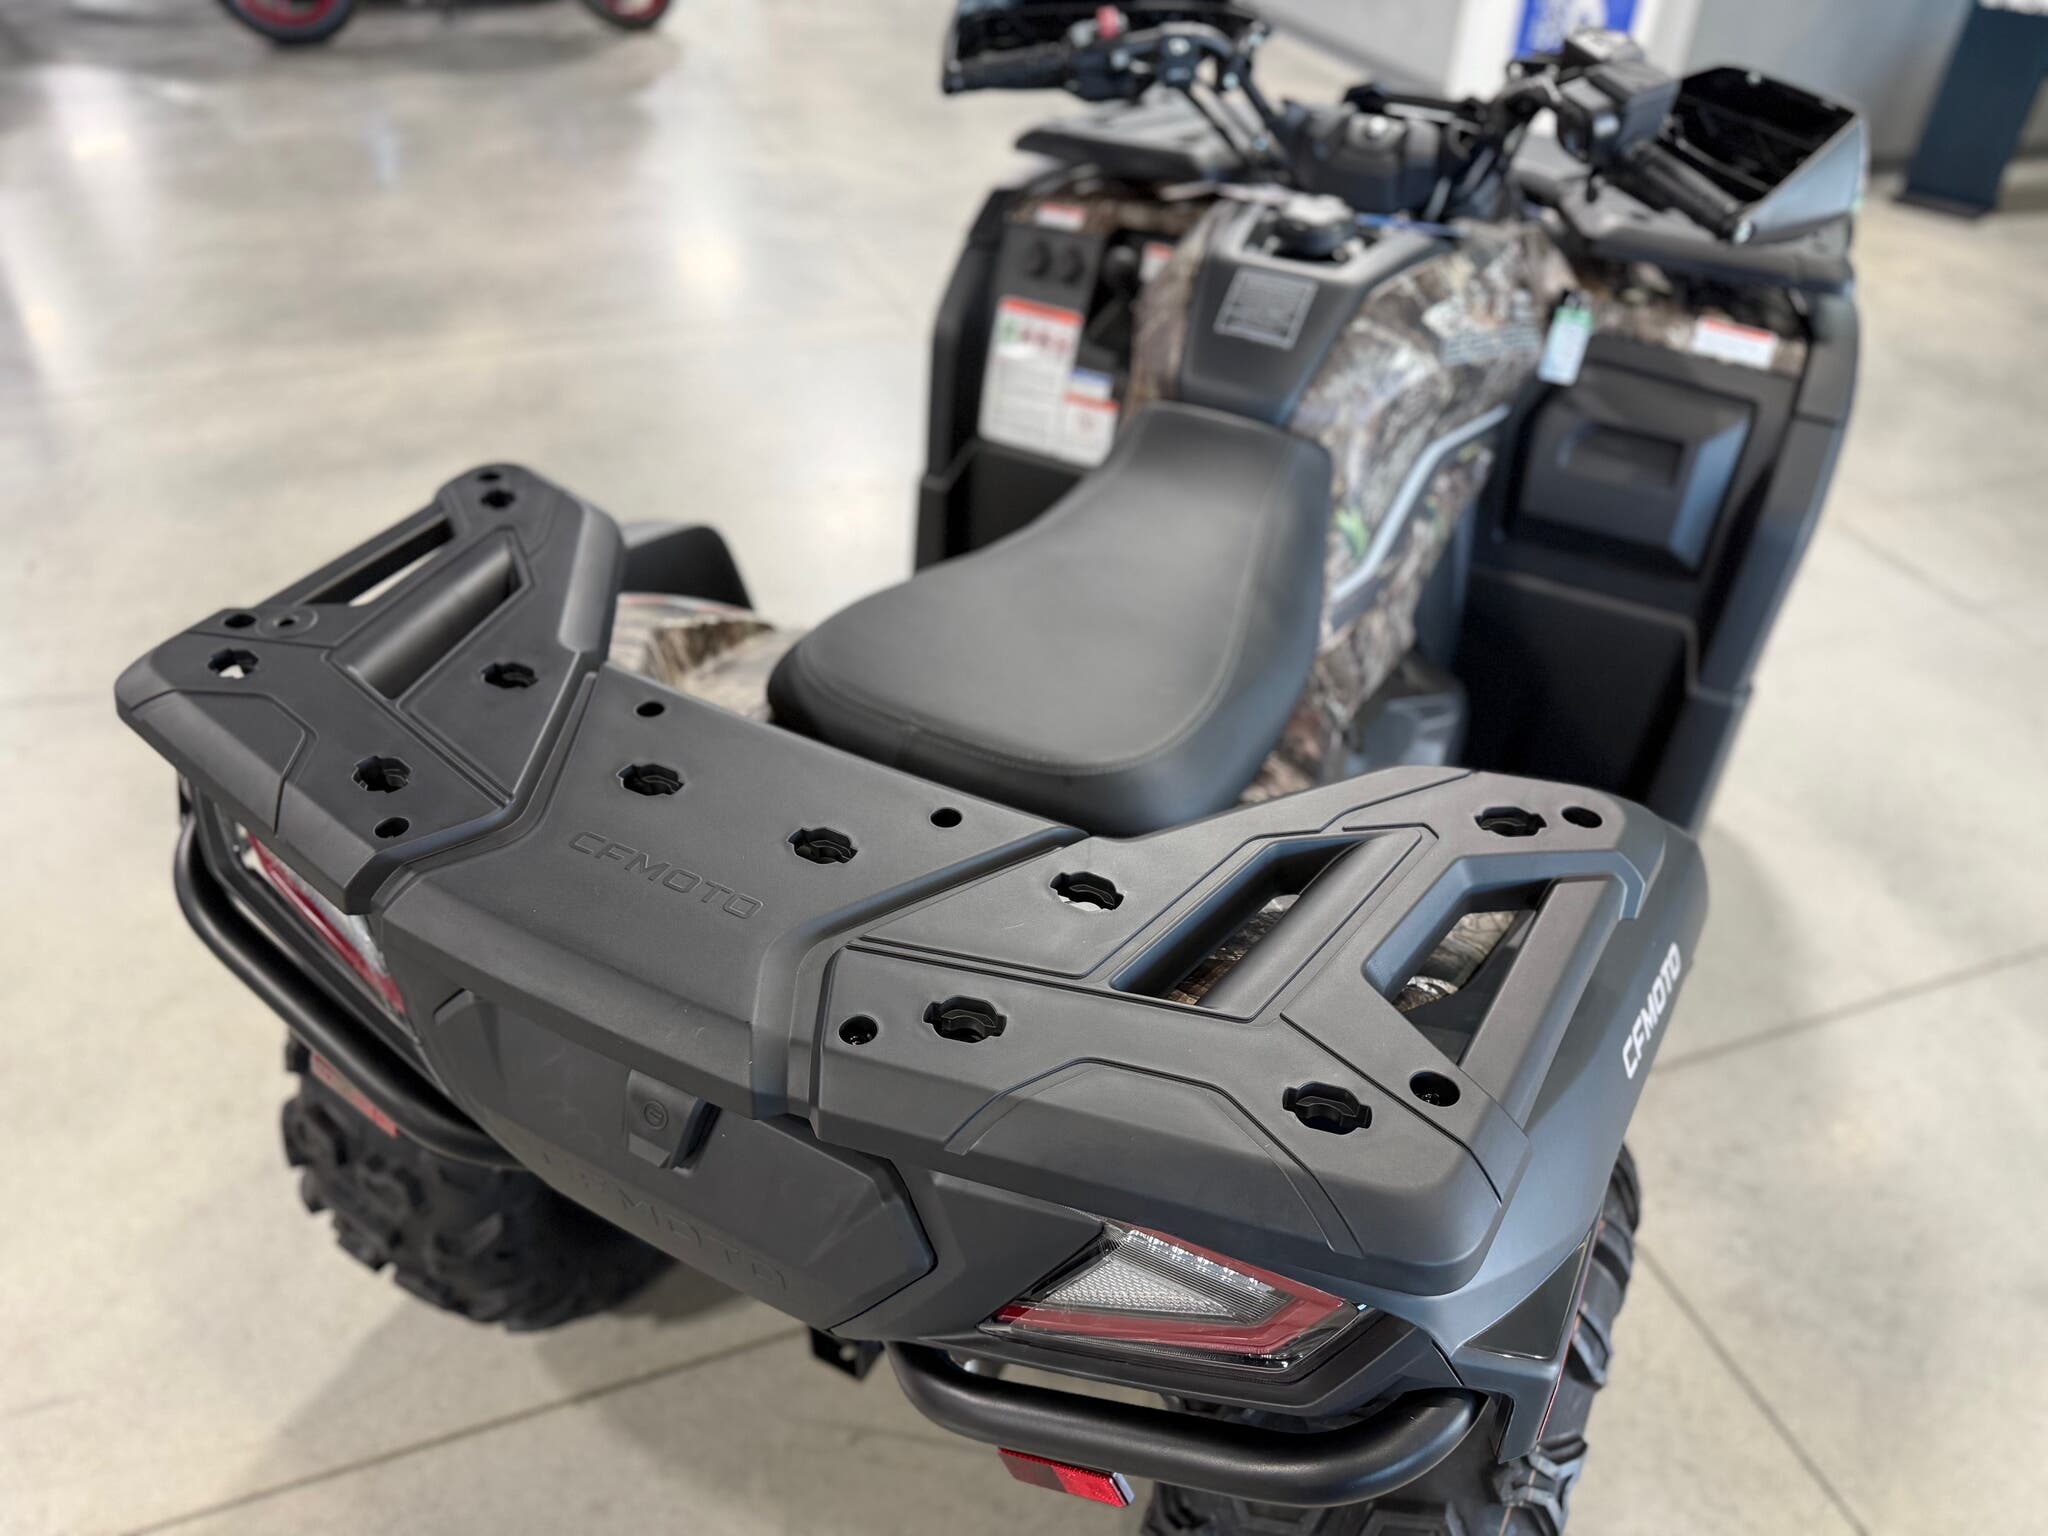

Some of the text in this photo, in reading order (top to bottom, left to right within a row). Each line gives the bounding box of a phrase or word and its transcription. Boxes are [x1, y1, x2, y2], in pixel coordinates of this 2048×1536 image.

[568, 831, 764, 920] CFMOTO
[1622, 941, 1682, 1080] CFMOTO
[542, 1149, 789, 1293] MOTO
